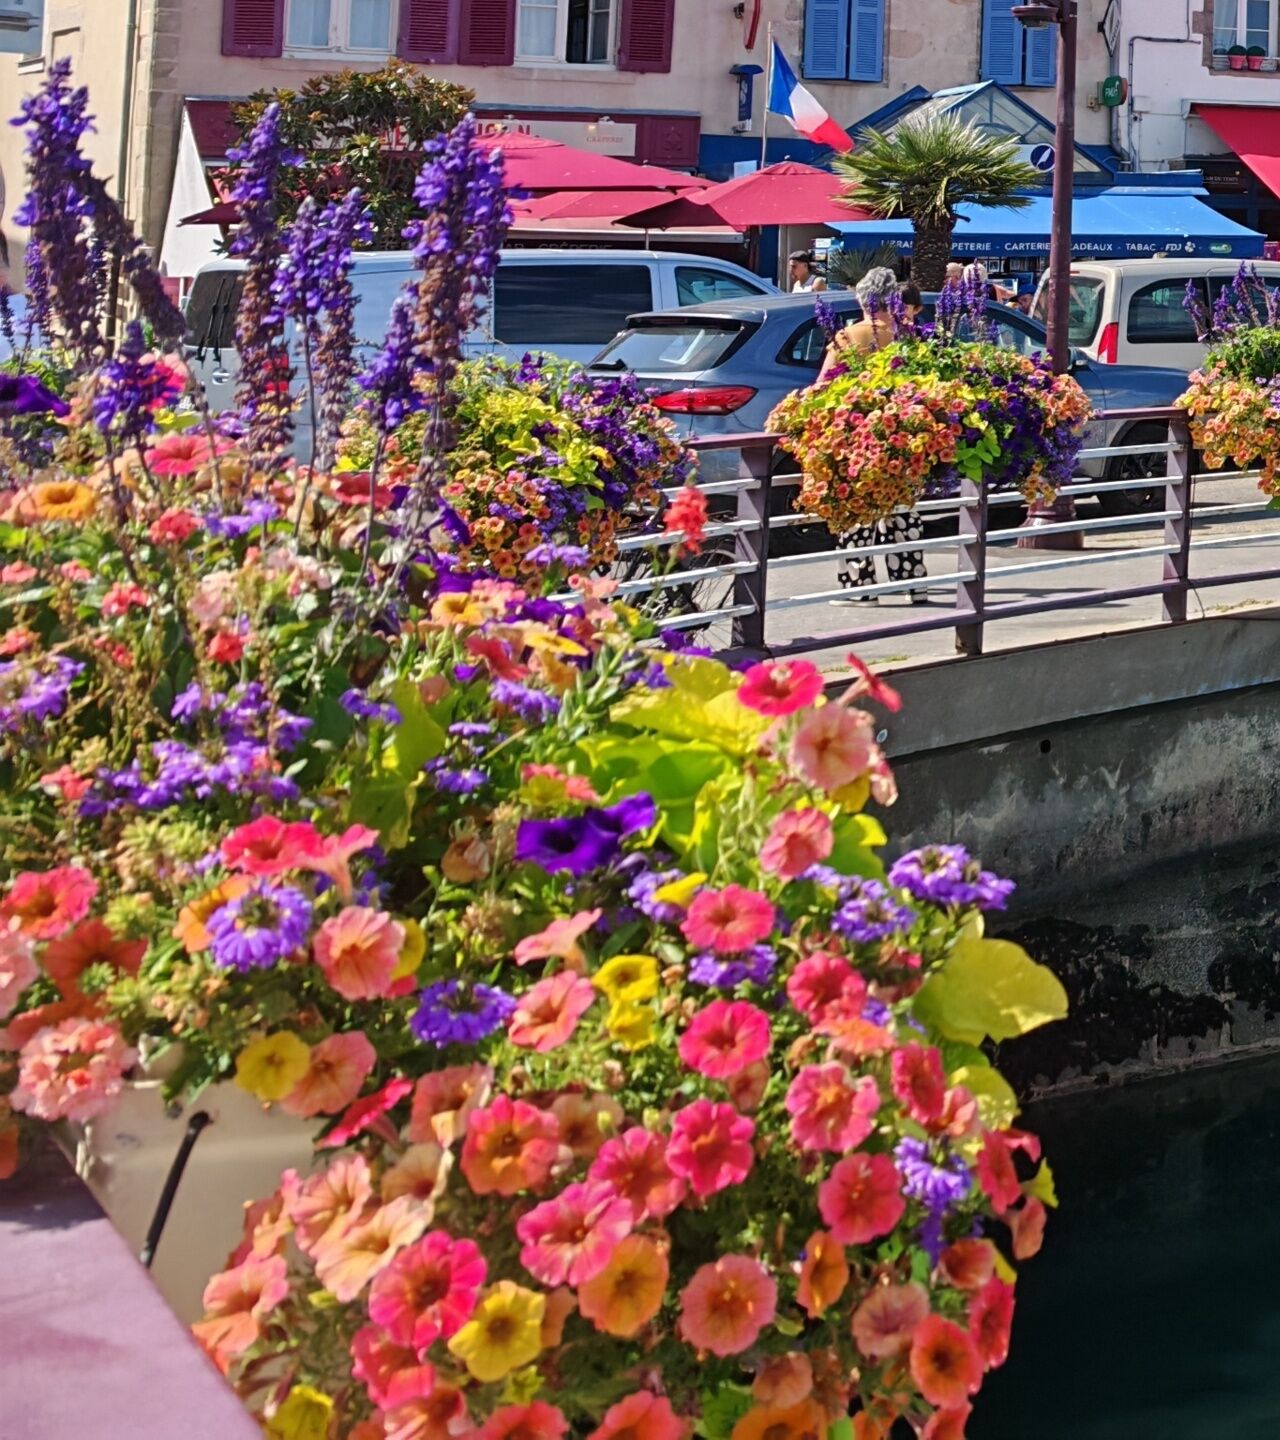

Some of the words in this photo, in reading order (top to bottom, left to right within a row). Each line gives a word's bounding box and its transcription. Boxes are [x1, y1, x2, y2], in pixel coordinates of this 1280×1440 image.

[1070, 242, 1113, 251] ADEAUX
[1125, 242, 1157, 252] TABAC
[1165, 243, 1182, 252] FDJ
